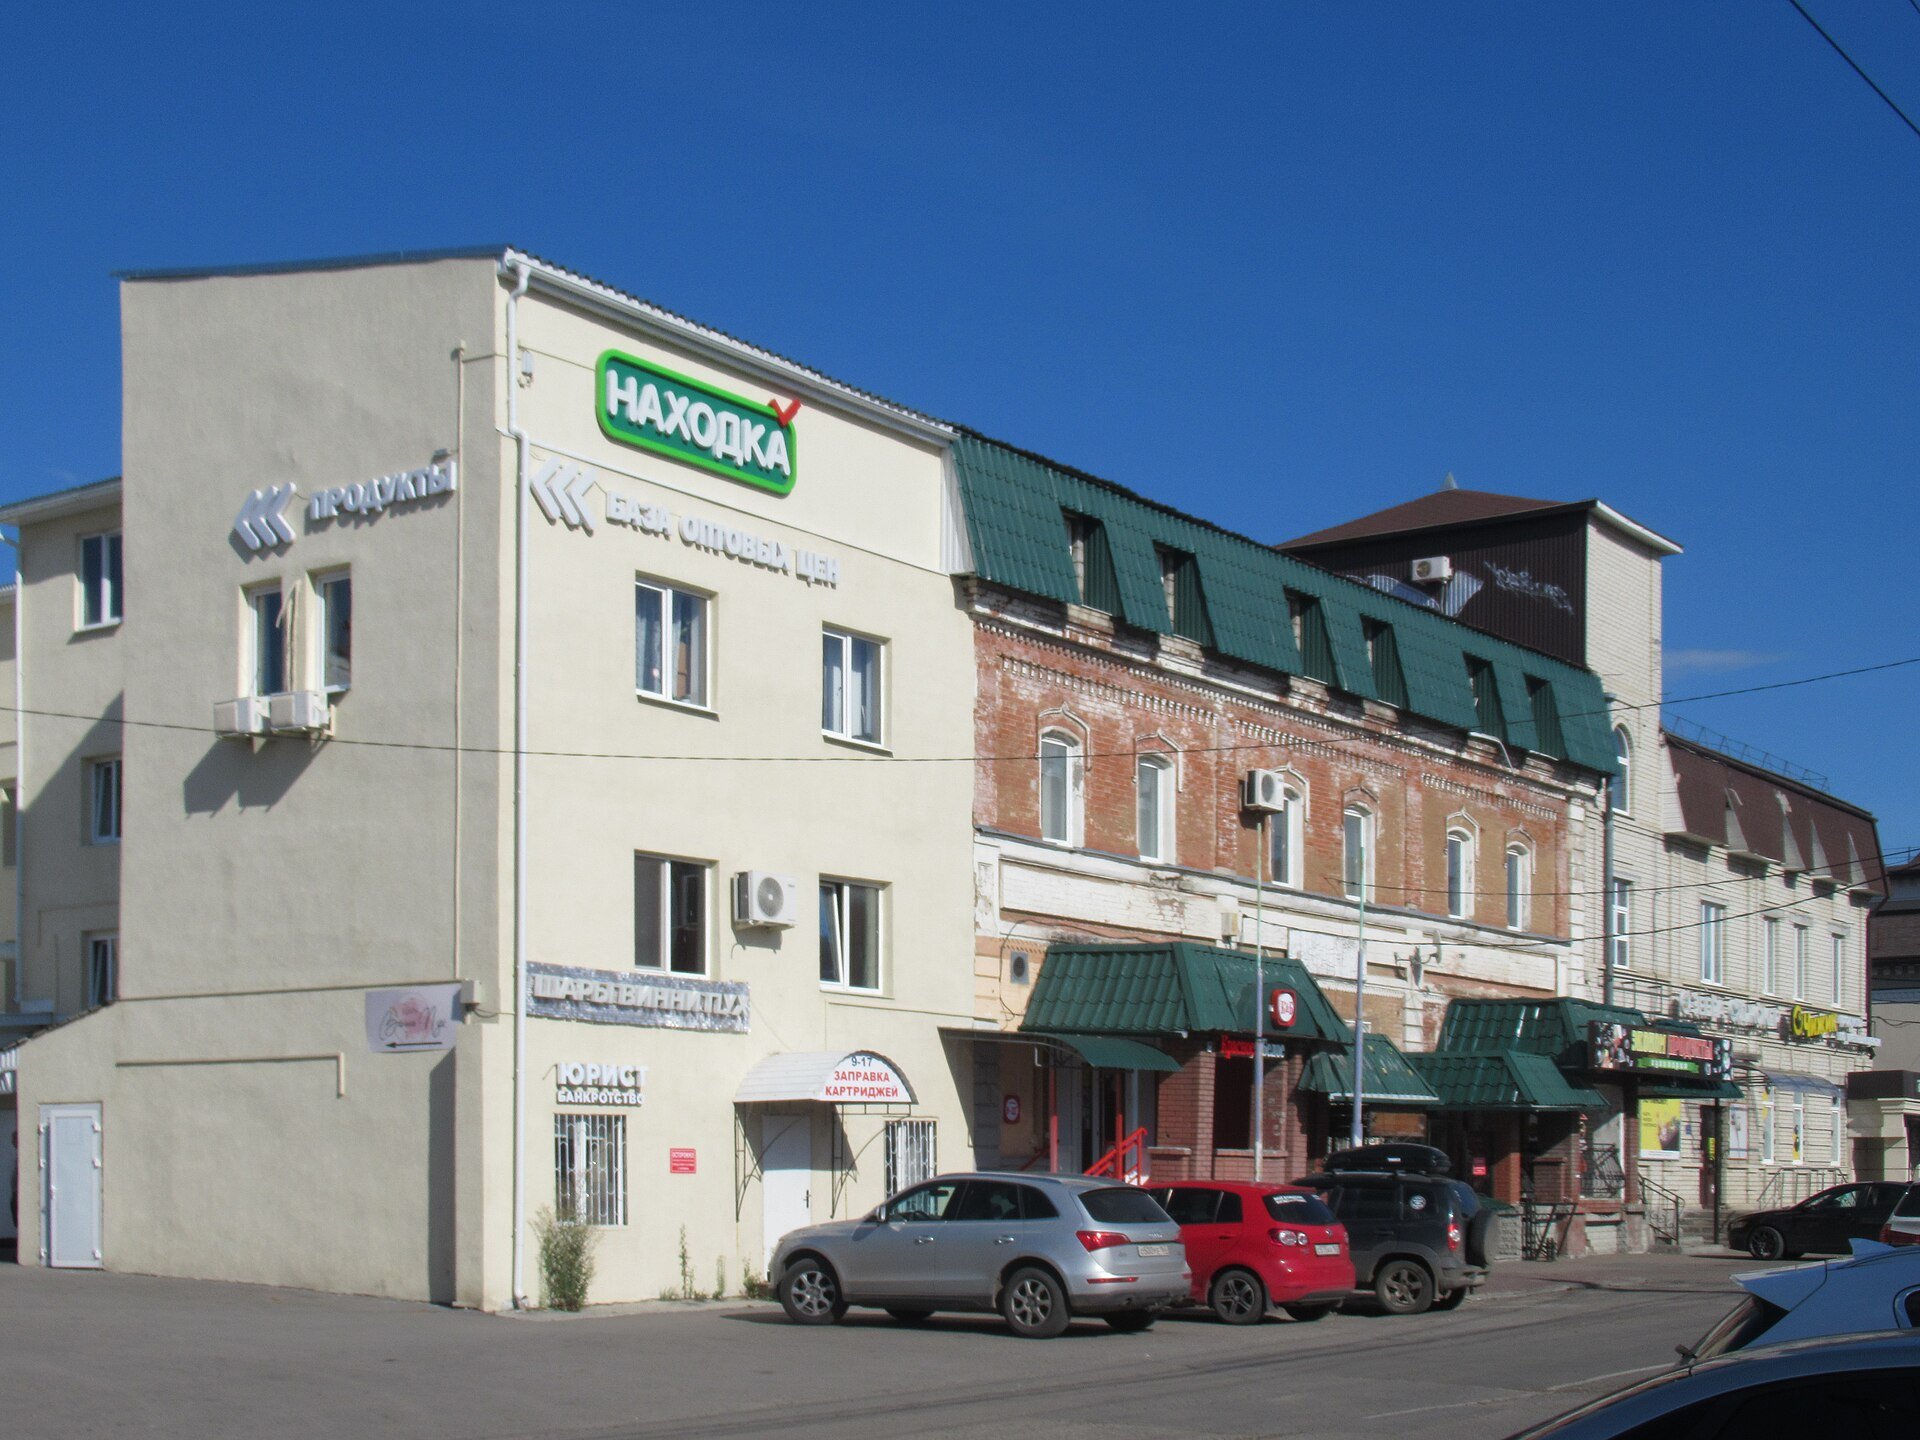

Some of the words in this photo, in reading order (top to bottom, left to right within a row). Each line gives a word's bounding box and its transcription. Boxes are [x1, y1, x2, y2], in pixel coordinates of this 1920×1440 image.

[606, 369, 791, 477] НАХОДКА
[309, 461, 457, 520] ПРОДУКТЫ
[606, 490, 673, 537] БАЗА
[679, 515, 791, 572] ОПТОВЫХ
[796, 547, 841, 586] ЦЕН
[851, 1056, 873, 1067] 9-17
[556, 1062, 649, 1087] ЮРИСТ
[834, 1071, 890, 1082] ЗАПРАВКА
[557, 1090, 646, 1105] БАНКРОТСТВО
[825, 1086, 899, 1099] КАРТРИДЖЕЙ
